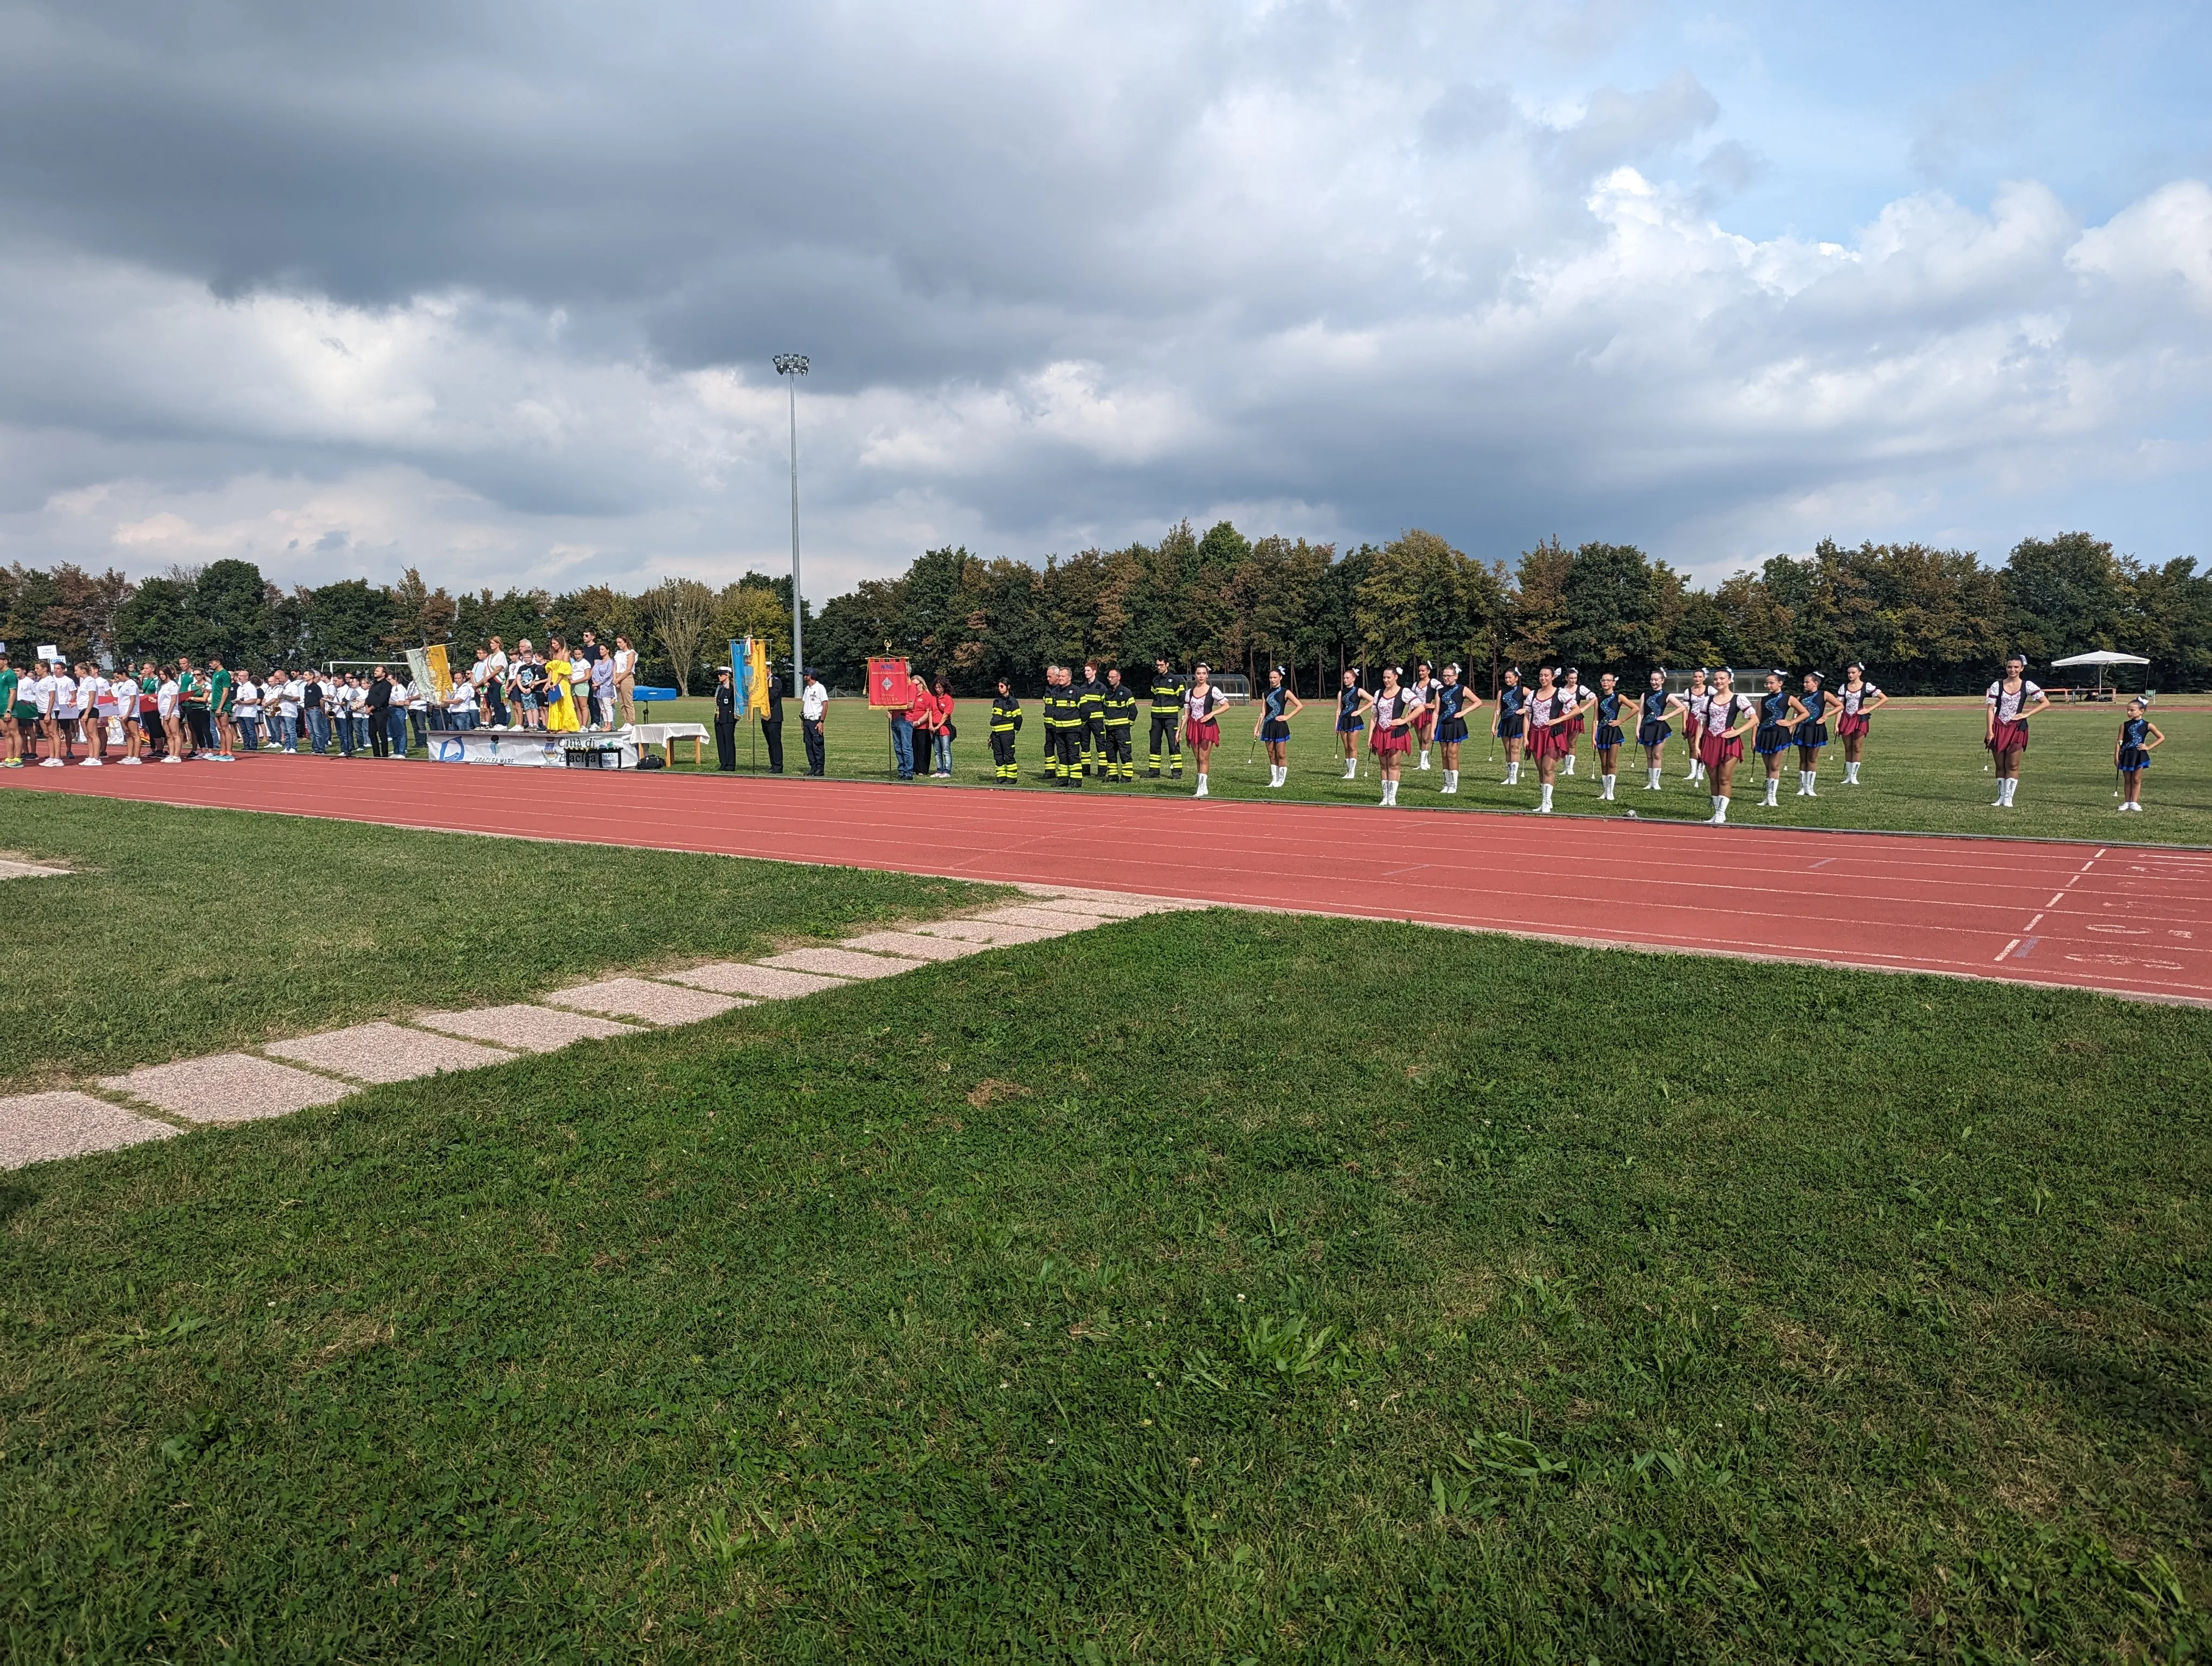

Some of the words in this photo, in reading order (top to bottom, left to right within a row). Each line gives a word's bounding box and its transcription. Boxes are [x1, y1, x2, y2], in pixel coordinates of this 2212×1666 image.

[558, 737, 582, 747] Città
[585, 738, 595, 748] di
[558, 752, 596, 762] Eacla
